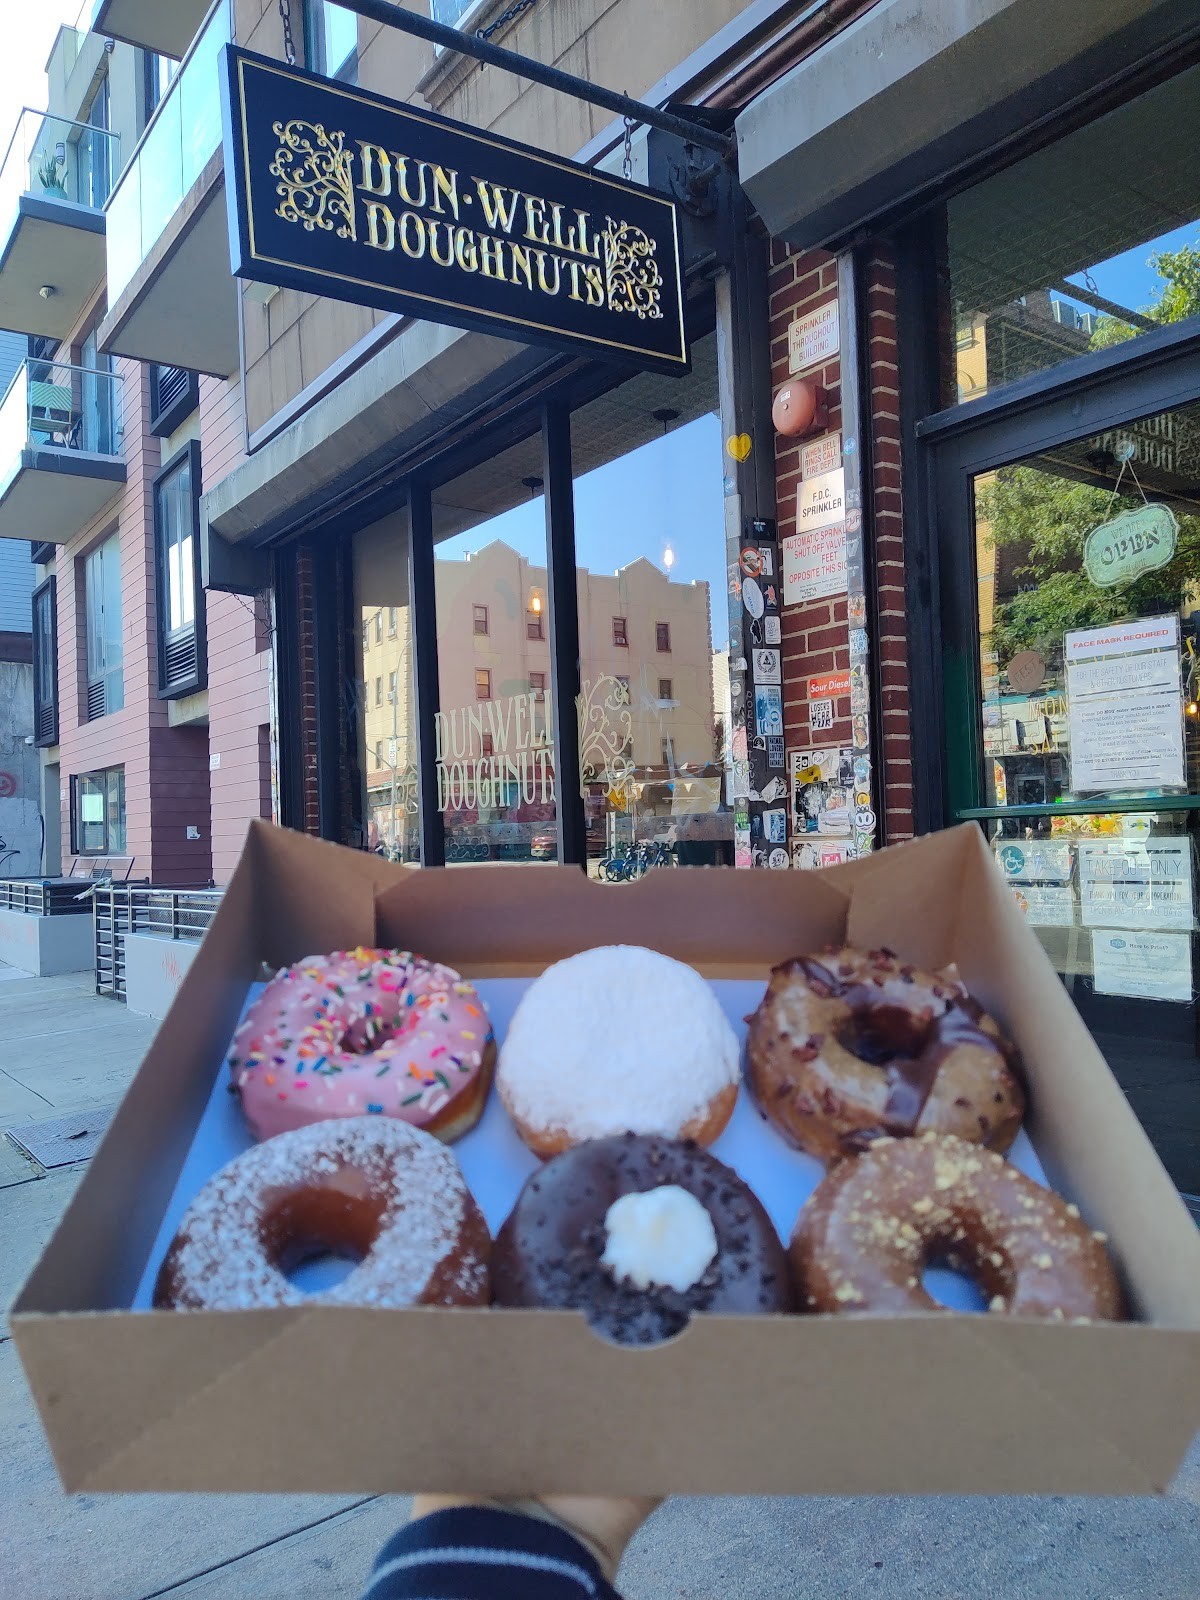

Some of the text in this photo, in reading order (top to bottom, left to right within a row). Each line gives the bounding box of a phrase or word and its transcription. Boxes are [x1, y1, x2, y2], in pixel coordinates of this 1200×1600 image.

[362, 197, 605, 308] DOUGHNUTS
[796, 310, 830, 336] SPRINKLER
[792, 322, 835, 351] THROUGHOUT
[799, 339, 829, 361] BUILDING
[805, 440, 836, 459] WHEN BELL
[805, 449, 837, 467] RINGS CALL
[806, 465, 818, 475] FIRE
[813, 488, 831, 502] F.D.C.
[802, 497, 842, 518] SPRINKLER
[794, 547, 810, 559] SHUT
[812, 542, 824, 554] OFF
[1101, 524, 1160, 565] OPEN
[822, 551, 837, 563] FEET
[789, 567, 820, 584] OPPOSITE
[822, 564, 835, 575] THIS
[1073, 629, 1169, 648] FACE MASK REQUIRED
[1101, 665, 1124, 676] SAFETY
[1148, 658, 1168, 668] STAFF
[811, 677, 850, 693] Sour Diesel
[811, 702, 829, 712] LOSERS
[811, 711, 829, 721] WEAR
[812, 719, 830, 728] FUR
[1031, 731, 1059, 755] SAT
[1151, 859, 1182, 875] ONLY
